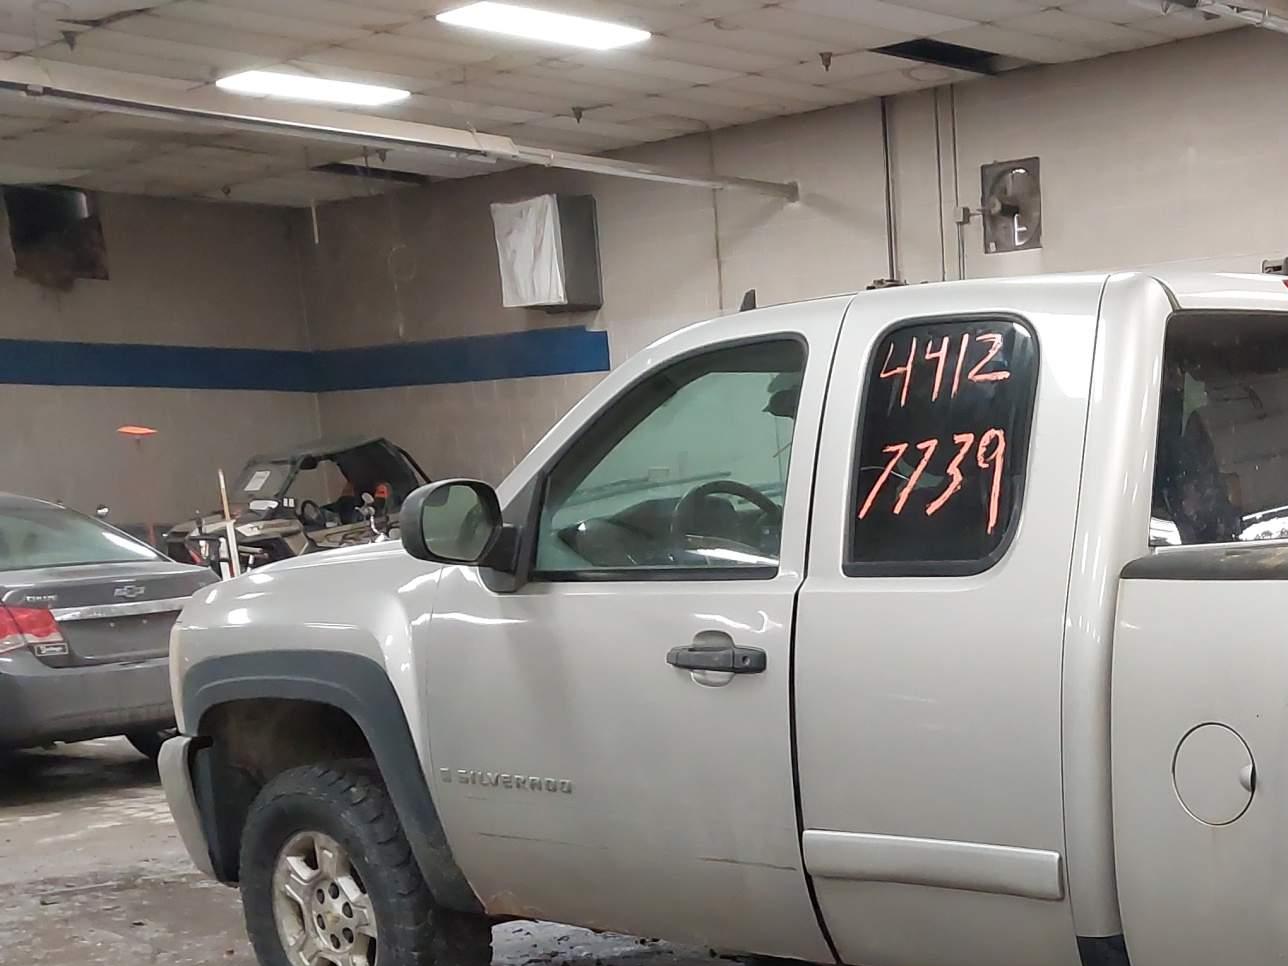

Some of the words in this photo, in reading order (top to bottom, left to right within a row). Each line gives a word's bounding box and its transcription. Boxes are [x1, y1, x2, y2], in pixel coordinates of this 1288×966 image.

[880, 333, 1011, 407] 4412
[858, 428, 1006, 535] 7739
[456, 767, 574, 795] SILVERADO
